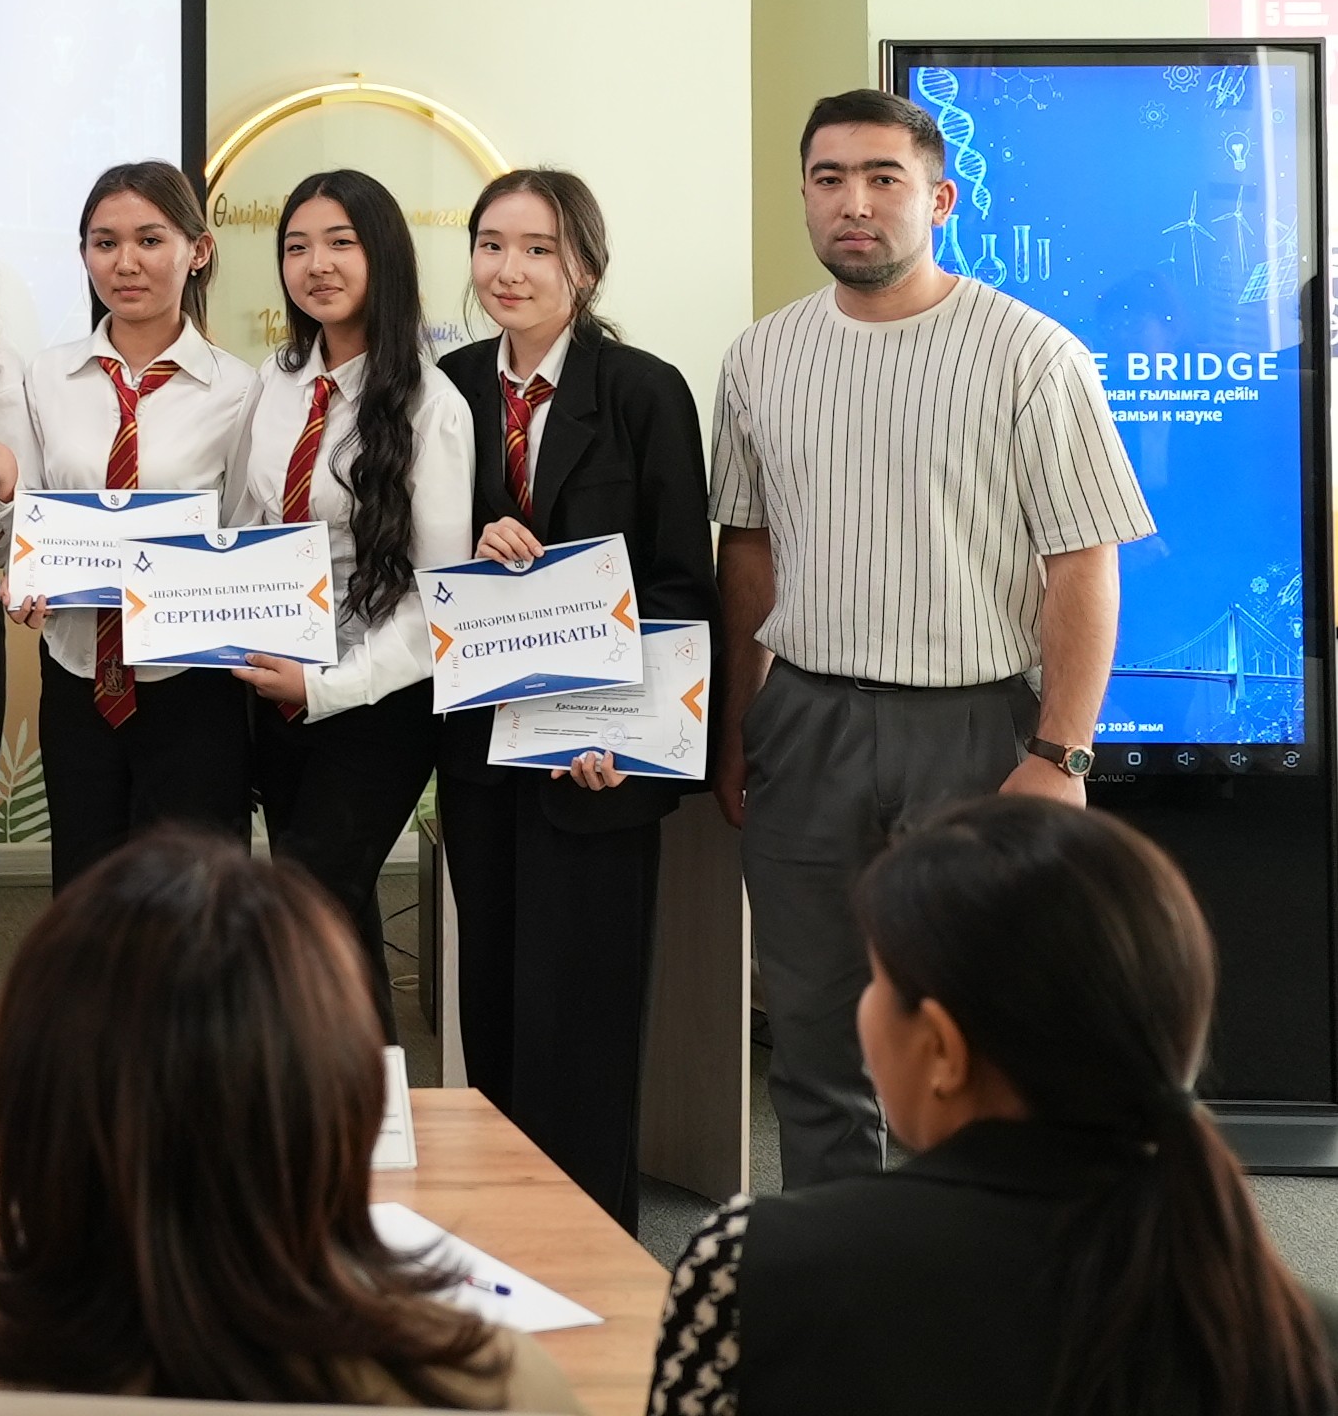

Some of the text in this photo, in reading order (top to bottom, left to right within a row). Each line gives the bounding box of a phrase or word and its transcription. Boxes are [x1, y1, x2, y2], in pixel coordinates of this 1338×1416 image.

[1127, 351, 1280, 381] BRIDGE
[1139, 389, 1210, 401] ғылымға
[1213, 386, 1259, 404] дейін
[1109, 410, 1223, 425] камьи к науке
[40, 554, 122, 569] СЕРТИФ
[215, 585, 249, 596] БІЛІМ
[154, 603, 302, 625] СЕРТИФИКАТЫ
[518, 607, 554, 622] БІЛІМ
[461, 623, 608, 660] СЕРТИФИКАТЫ
[1108, 721, 1136, 732] 2026
[1138, 723, 1164, 732] жыл
